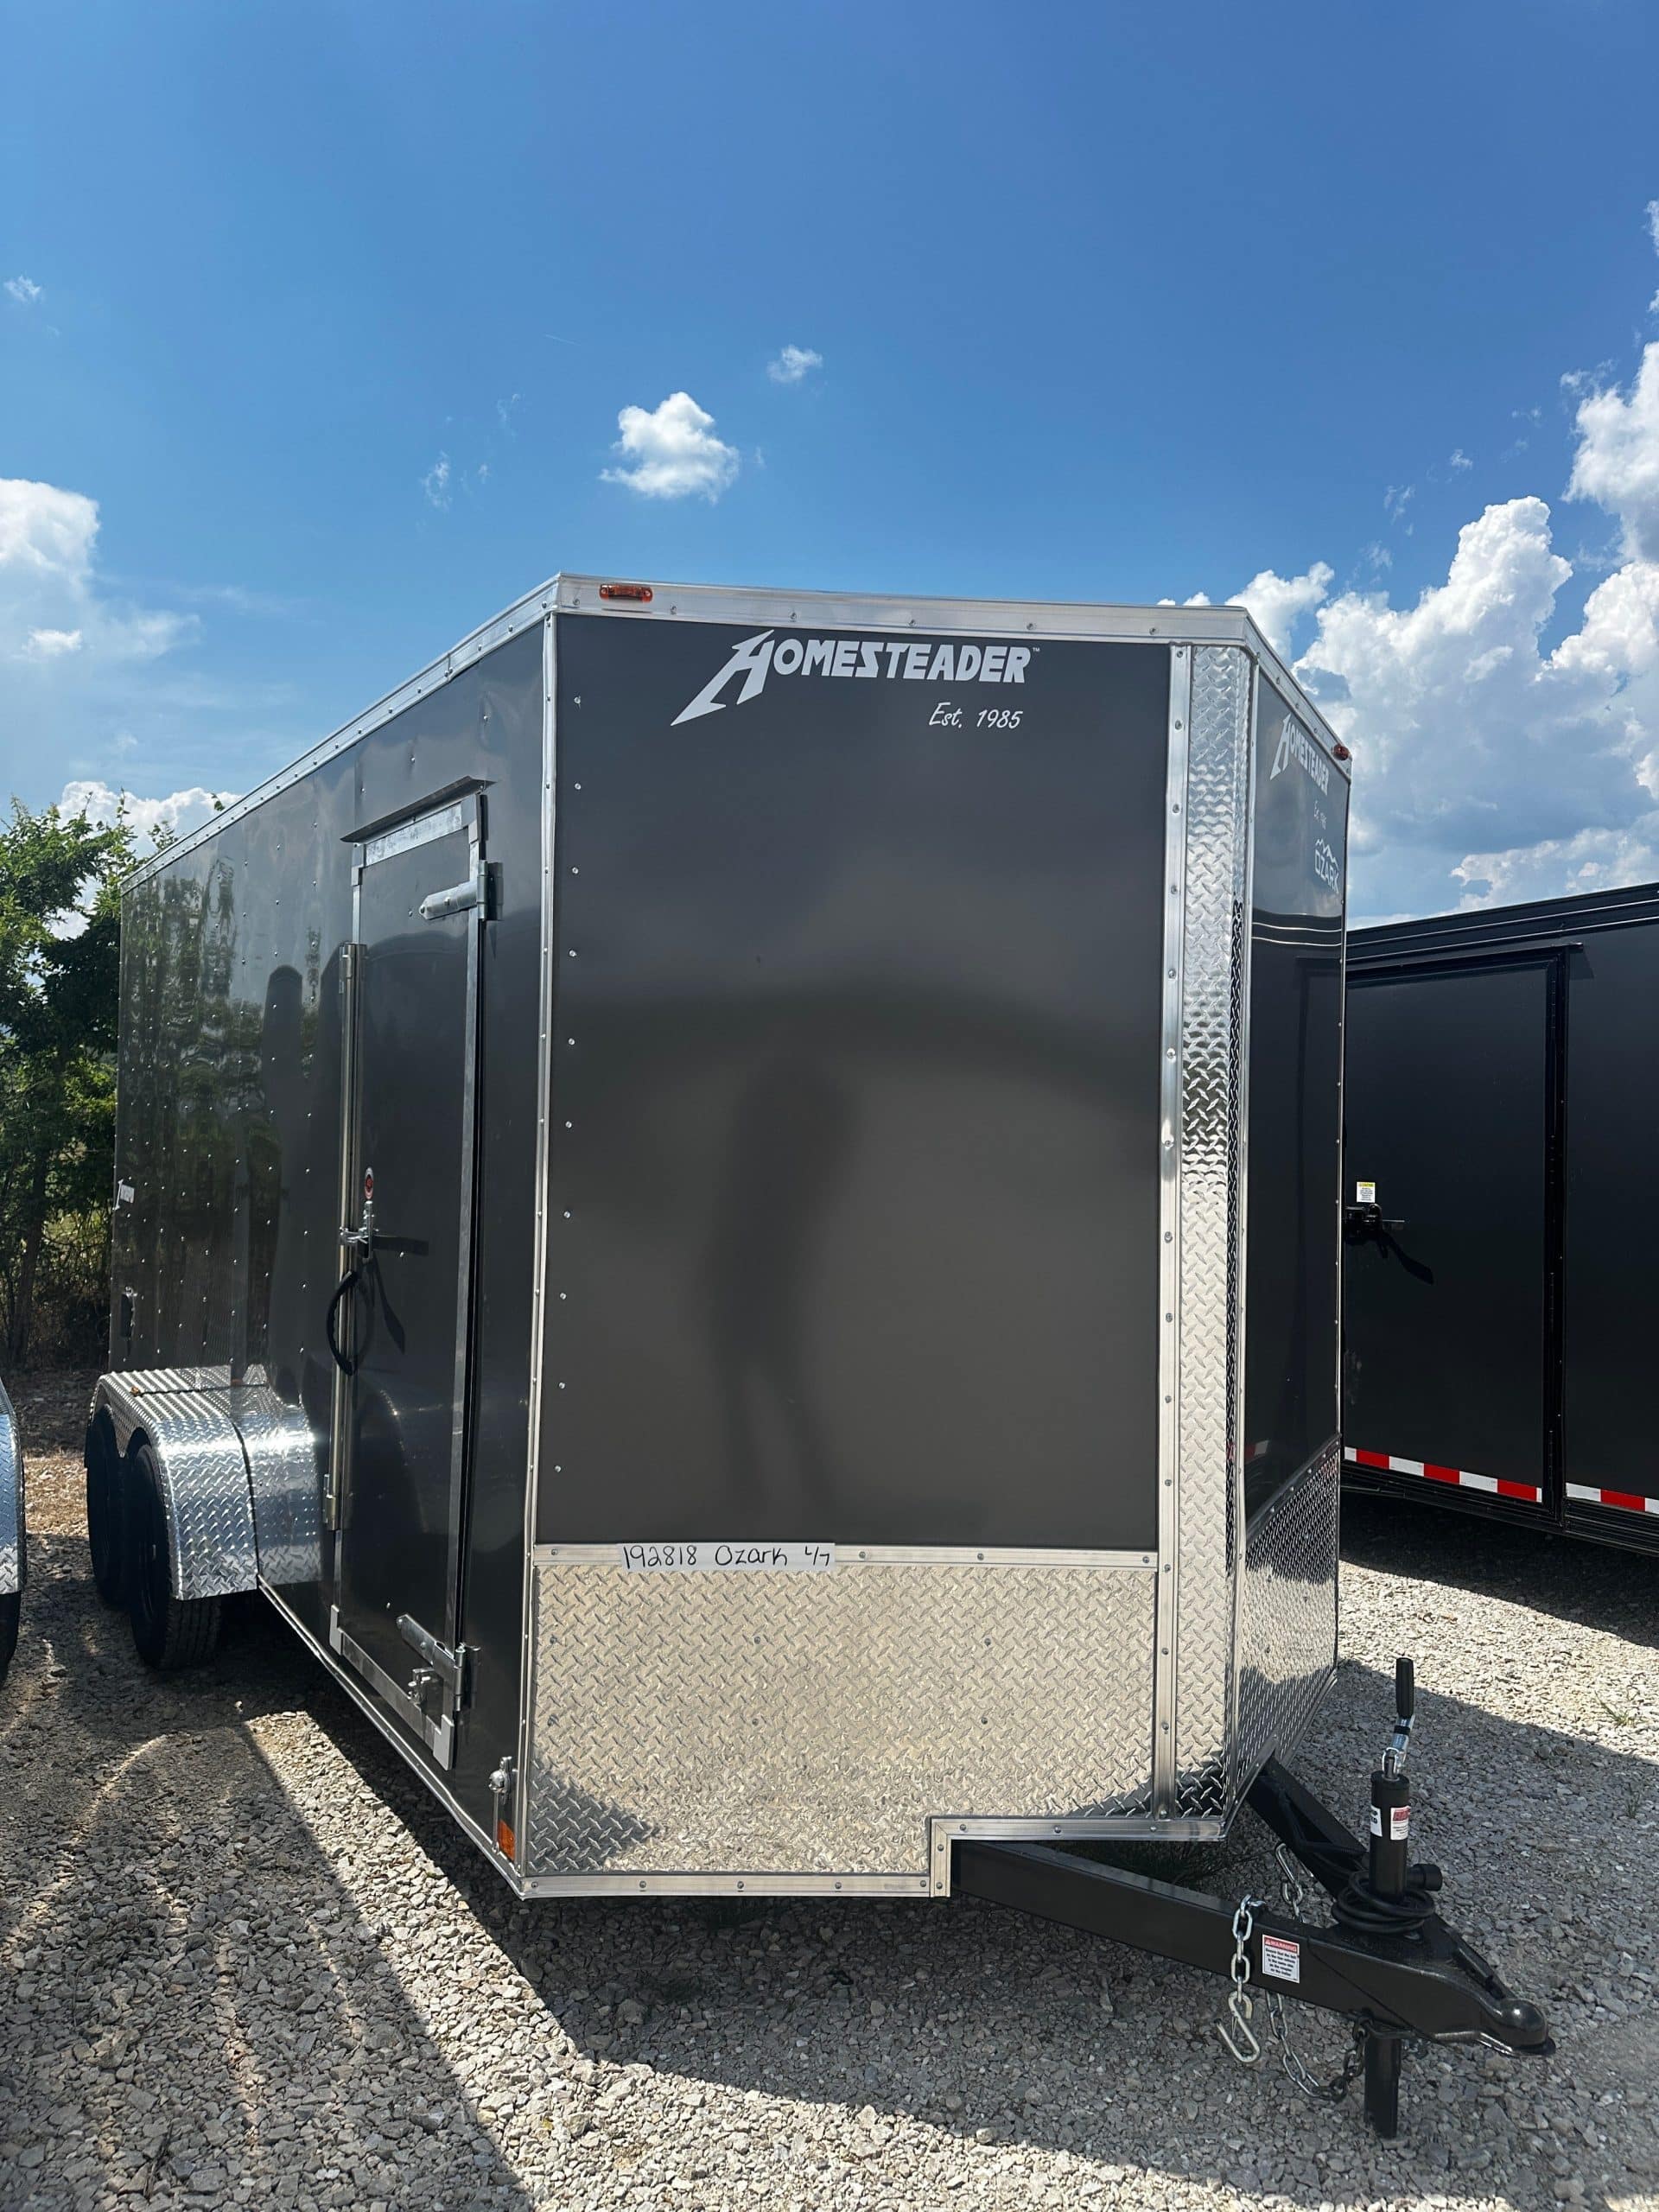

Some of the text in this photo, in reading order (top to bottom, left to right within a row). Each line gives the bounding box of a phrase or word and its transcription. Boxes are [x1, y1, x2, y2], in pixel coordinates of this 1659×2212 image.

[671, 629, 1031, 727] HOMESTEADER
[929, 702, 1024, 729] Est. 1985
[1269, 713, 1329, 797] HOMESTEADER
[1315, 849, 1339, 895] OZARK
[623, 1545, 697, 1570] 192818
[715, 1545, 788, 1567] Ozark
